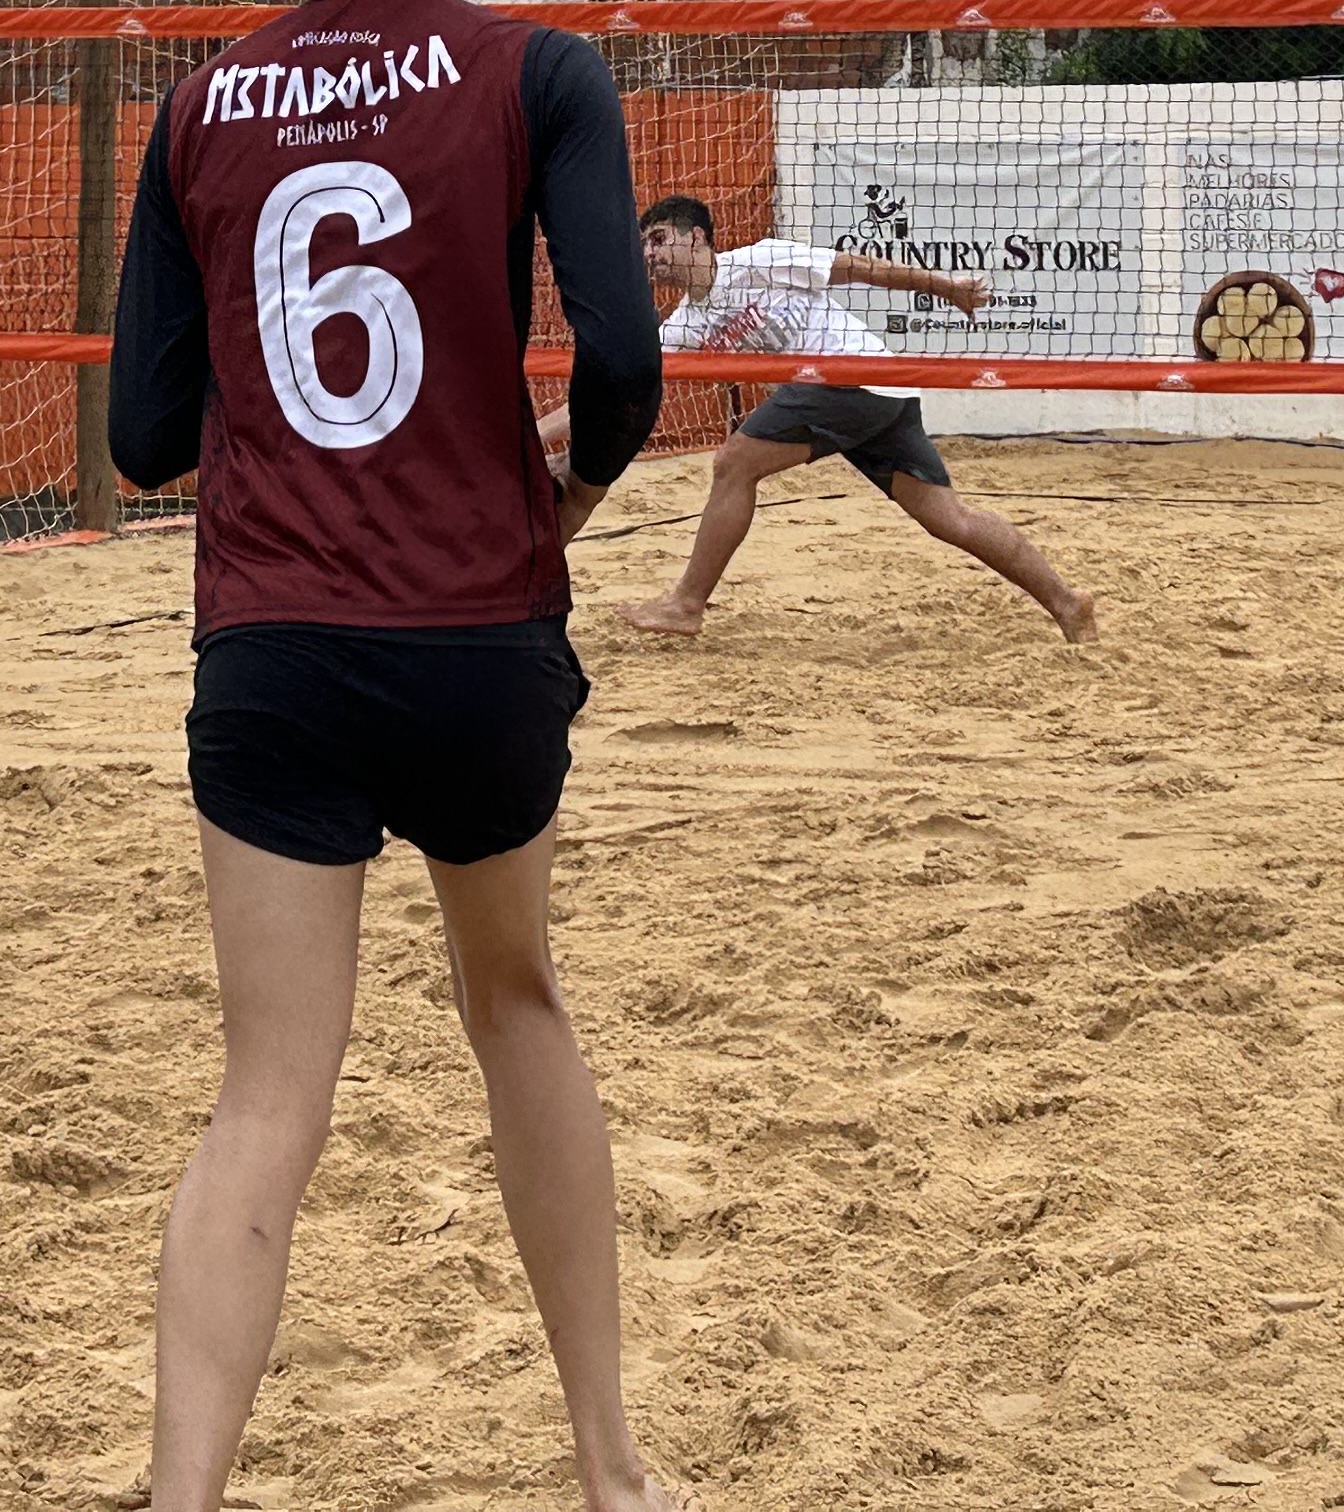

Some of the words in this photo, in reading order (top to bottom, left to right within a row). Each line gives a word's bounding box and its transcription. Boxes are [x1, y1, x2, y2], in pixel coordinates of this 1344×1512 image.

[1189, 193, 1289, 208] PADARIAS
[1003, 233, 1123, 272] STORE
[254, 160, 425, 450] 6
